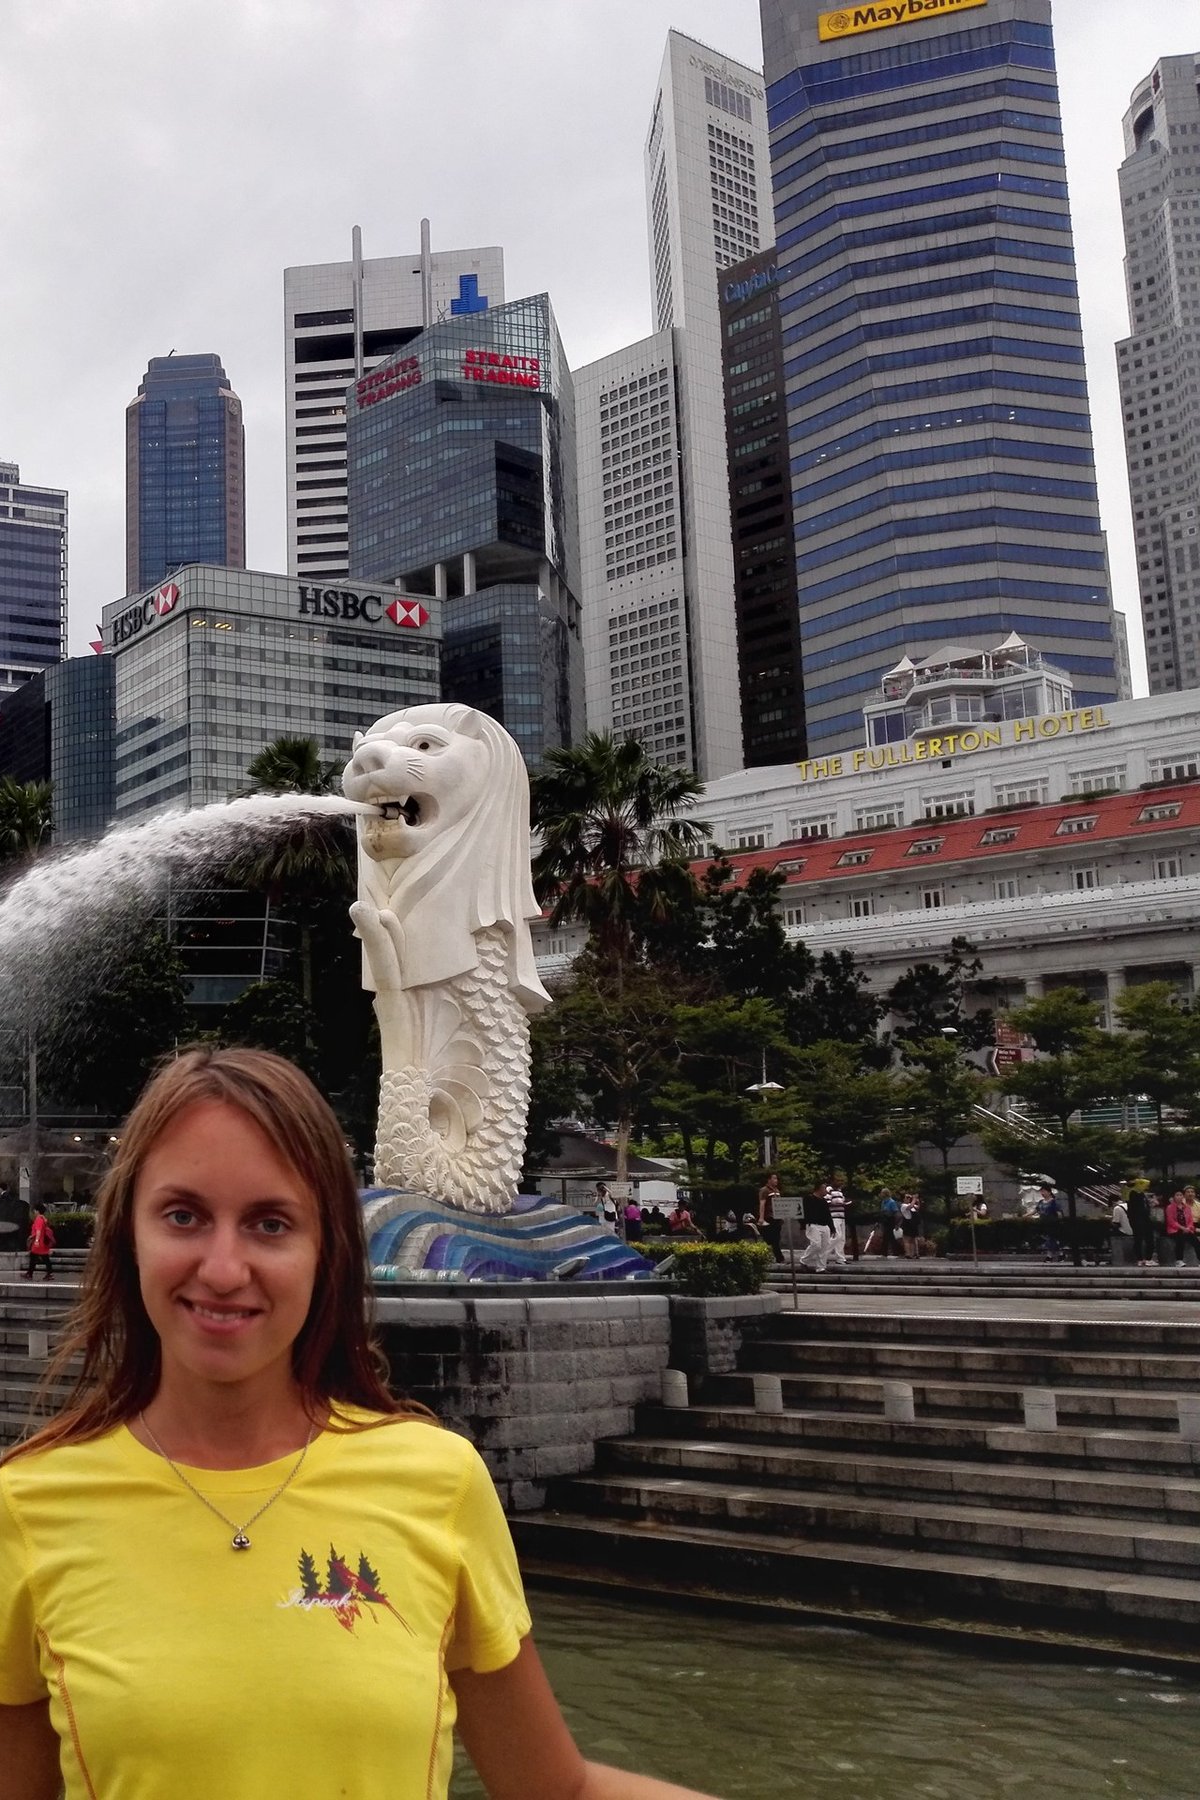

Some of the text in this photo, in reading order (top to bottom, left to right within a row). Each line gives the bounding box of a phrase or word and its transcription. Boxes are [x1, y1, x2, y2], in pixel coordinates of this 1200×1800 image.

[853, 0, 961, 26] Mayba
[357, 355, 419, 394] STRAITS
[461, 365, 540, 389] TRADING
[466, 349, 540, 372] STRAITS
[357, 371, 422, 409] TRADING
[111, 595, 156, 647] HSBC
[298, 586, 382, 622] HSBC
[796, 707, 1111, 781] THE FULLERTON HOTEL
[276, 1586, 353, 1611] Icepeak
